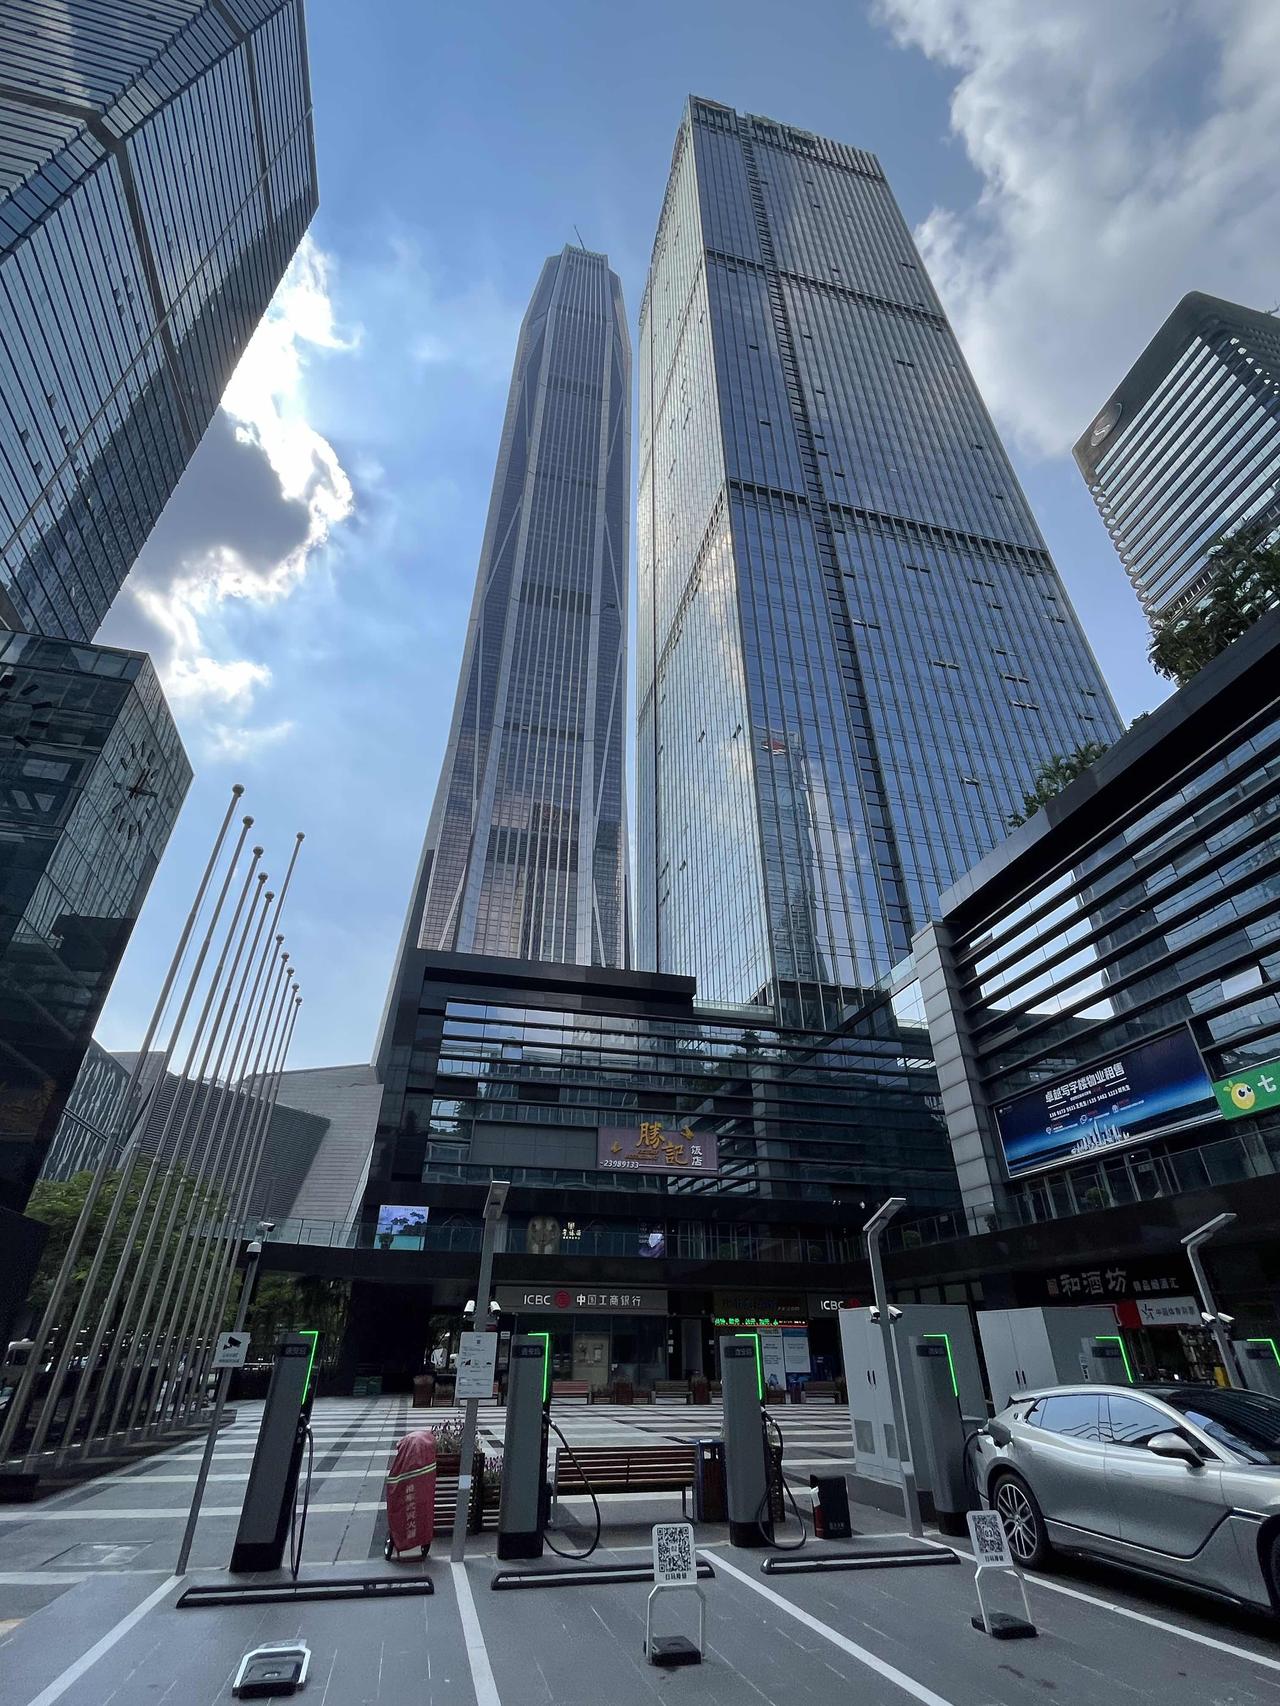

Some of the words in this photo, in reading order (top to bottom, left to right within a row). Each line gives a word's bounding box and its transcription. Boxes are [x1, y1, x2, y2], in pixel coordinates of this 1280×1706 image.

[1045, 1062, 1125, 1103] 卓越写字楼物业租售
[1257, 1074, 1277, 1093] 七
[690, 1145, 702, 1167] 饭店
[523, 1294, 551, 1305] ICBC
[576, 1293, 641, 1307] 中国工商银行
[820, 1300, 844, 1311] ICBC
